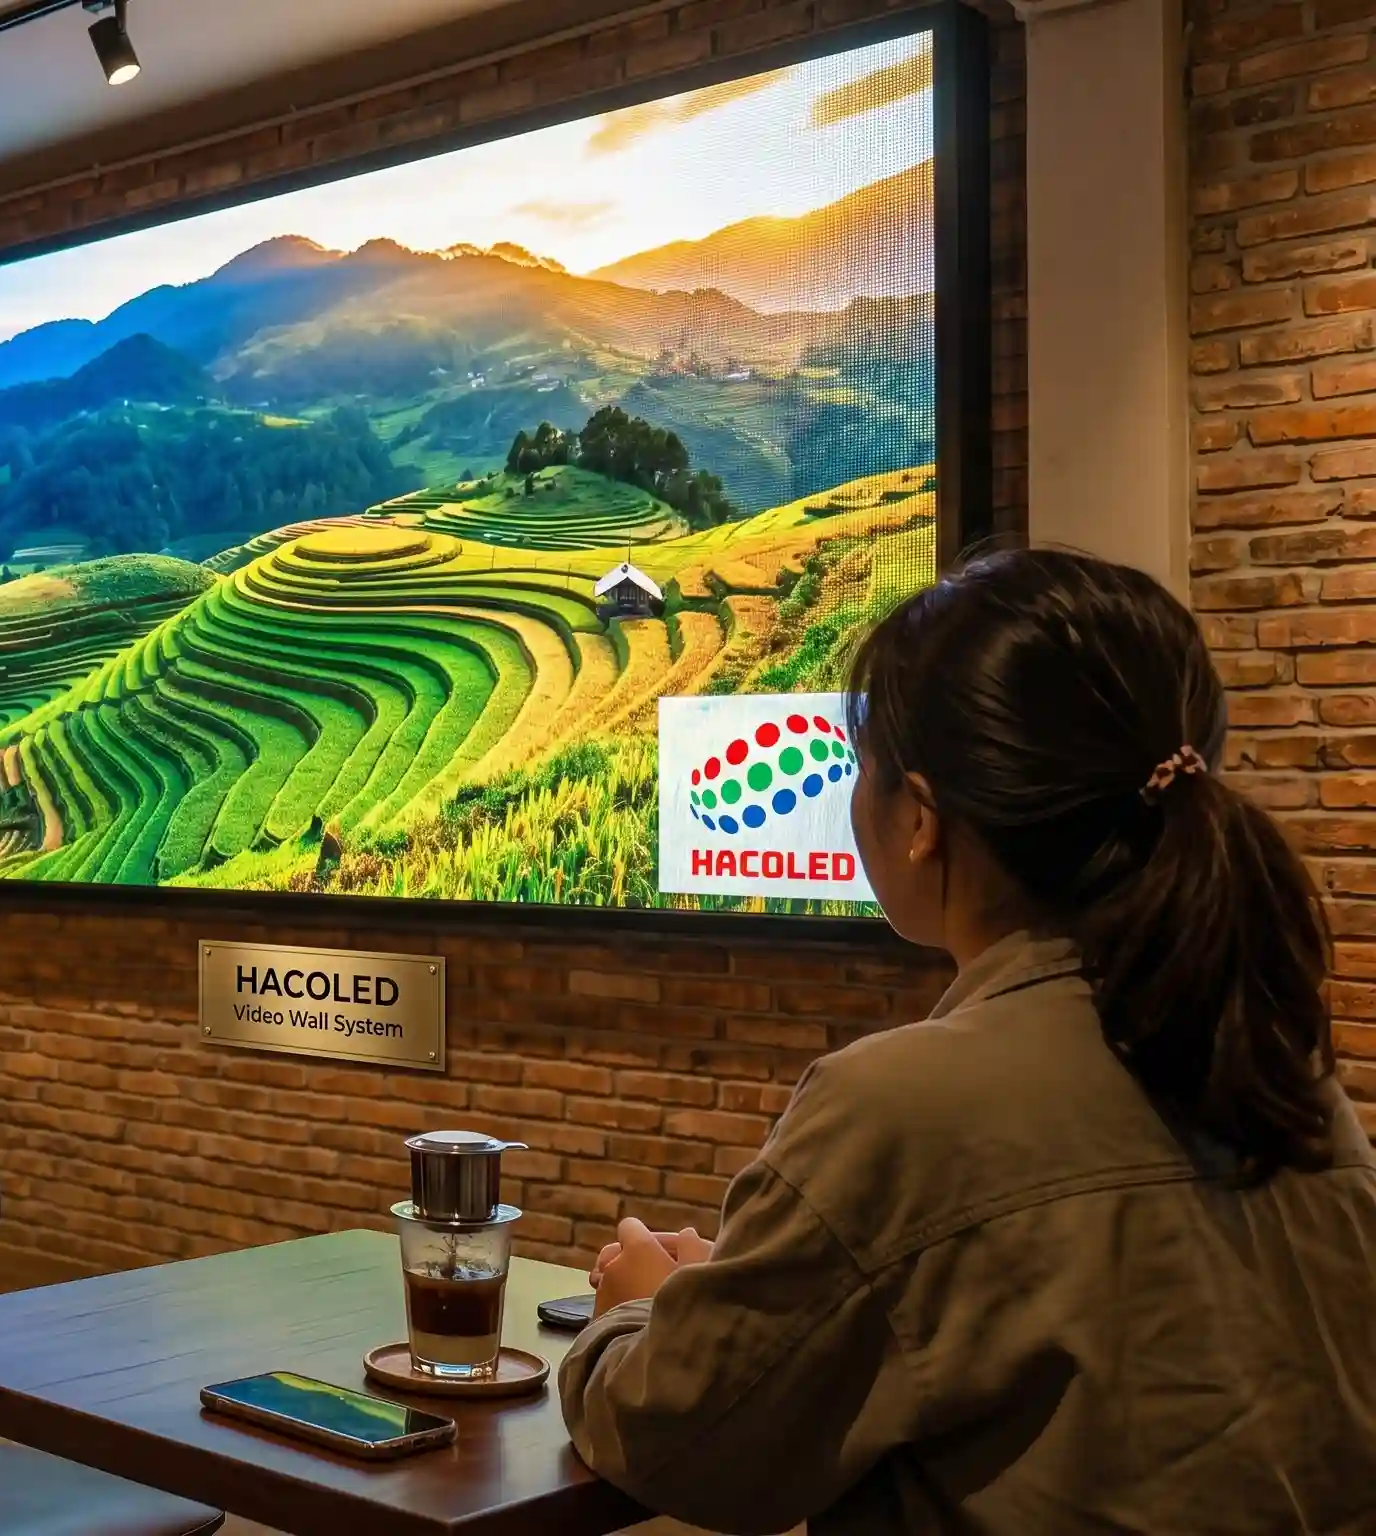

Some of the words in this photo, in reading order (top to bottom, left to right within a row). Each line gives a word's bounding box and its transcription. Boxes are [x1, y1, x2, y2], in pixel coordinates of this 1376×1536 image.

[691, 849, 855, 881] HACOLED
[236, 965, 399, 1006] HACOLED
[233, 1003, 284, 1025] Video
[288, 1009, 328, 1031] Wall
[334, 1014, 403, 1038] System
